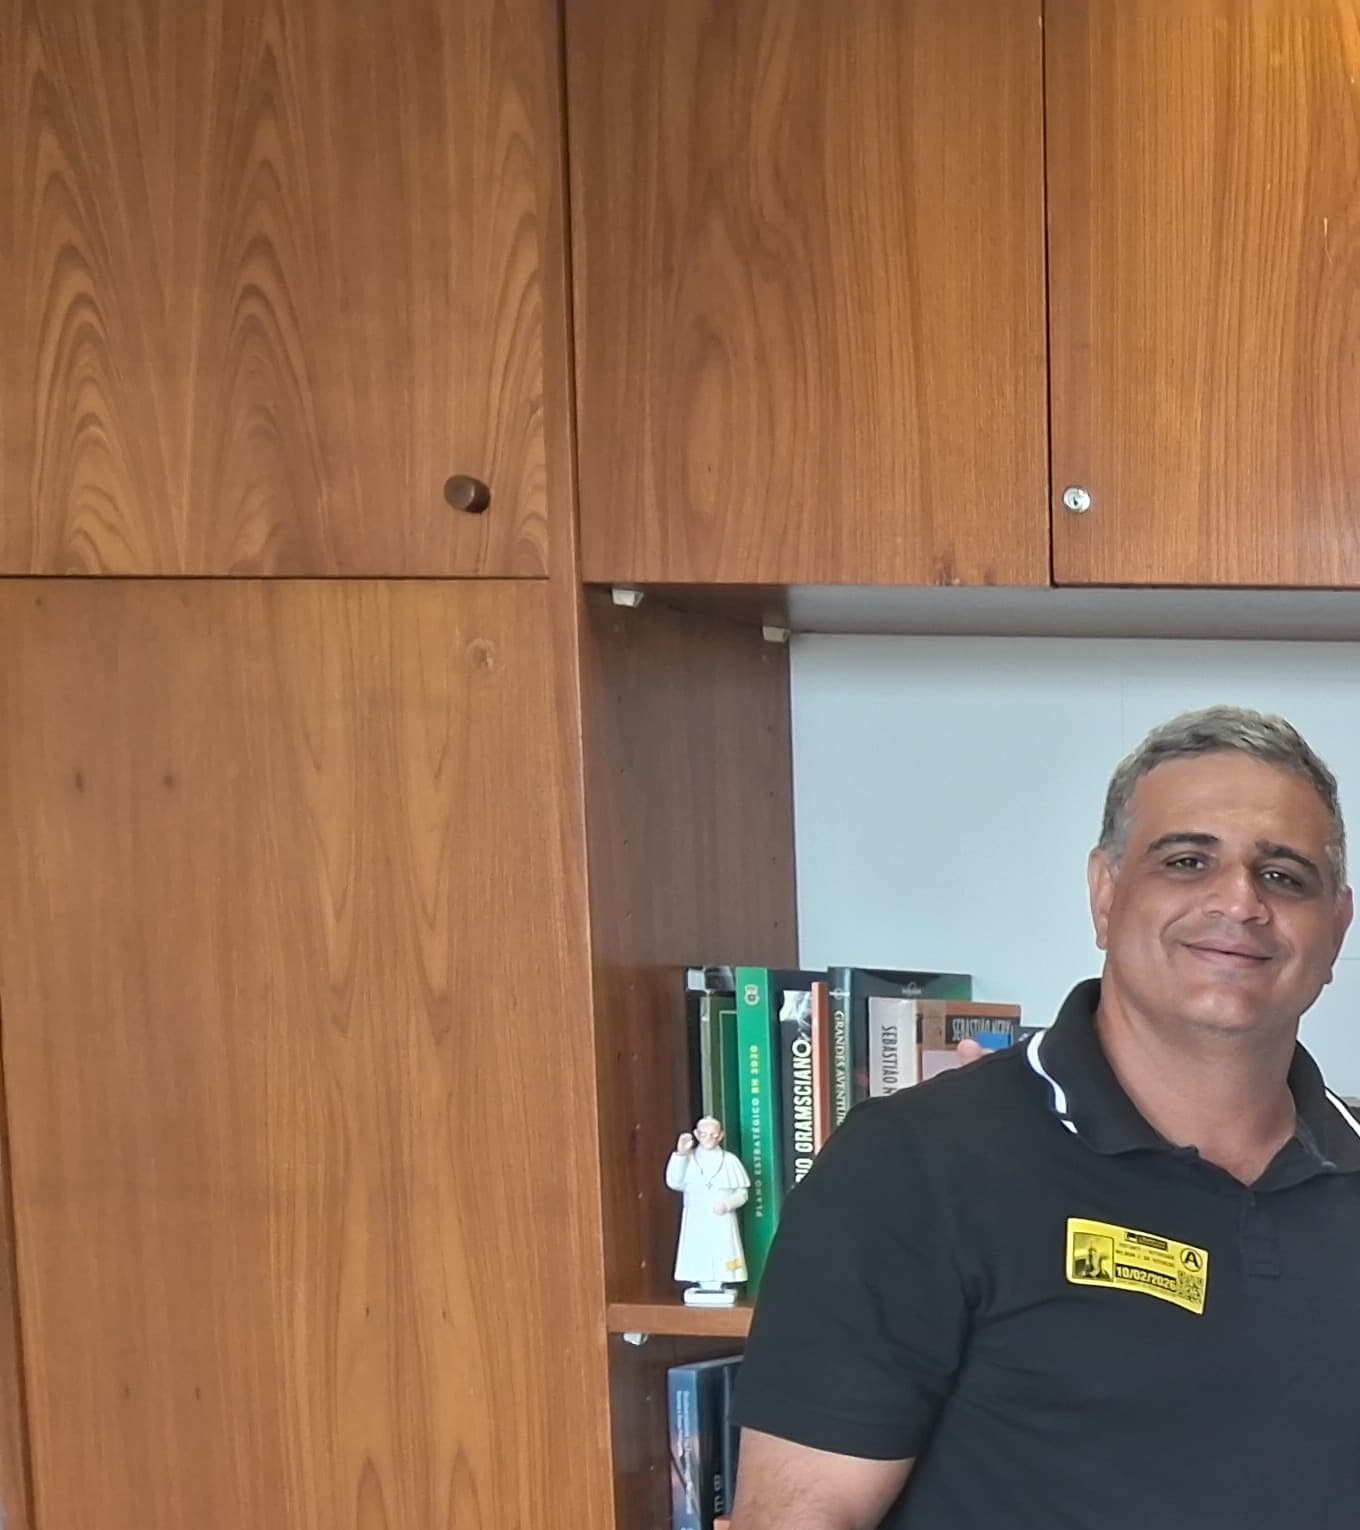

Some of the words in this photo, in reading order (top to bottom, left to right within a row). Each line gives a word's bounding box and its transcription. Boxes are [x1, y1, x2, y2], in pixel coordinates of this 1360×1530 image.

[833, 1010, 846, 1067] GRANDES
[749, 1045, 760, 1075] 2030
[792, 1038, 814, 1153] GRAMSCIANO
[754, 1180, 764, 1218] PLANO
[1184, 1250, 1200, 1268] A
[1116, 1265, 1177, 1291] 10/02/2026
